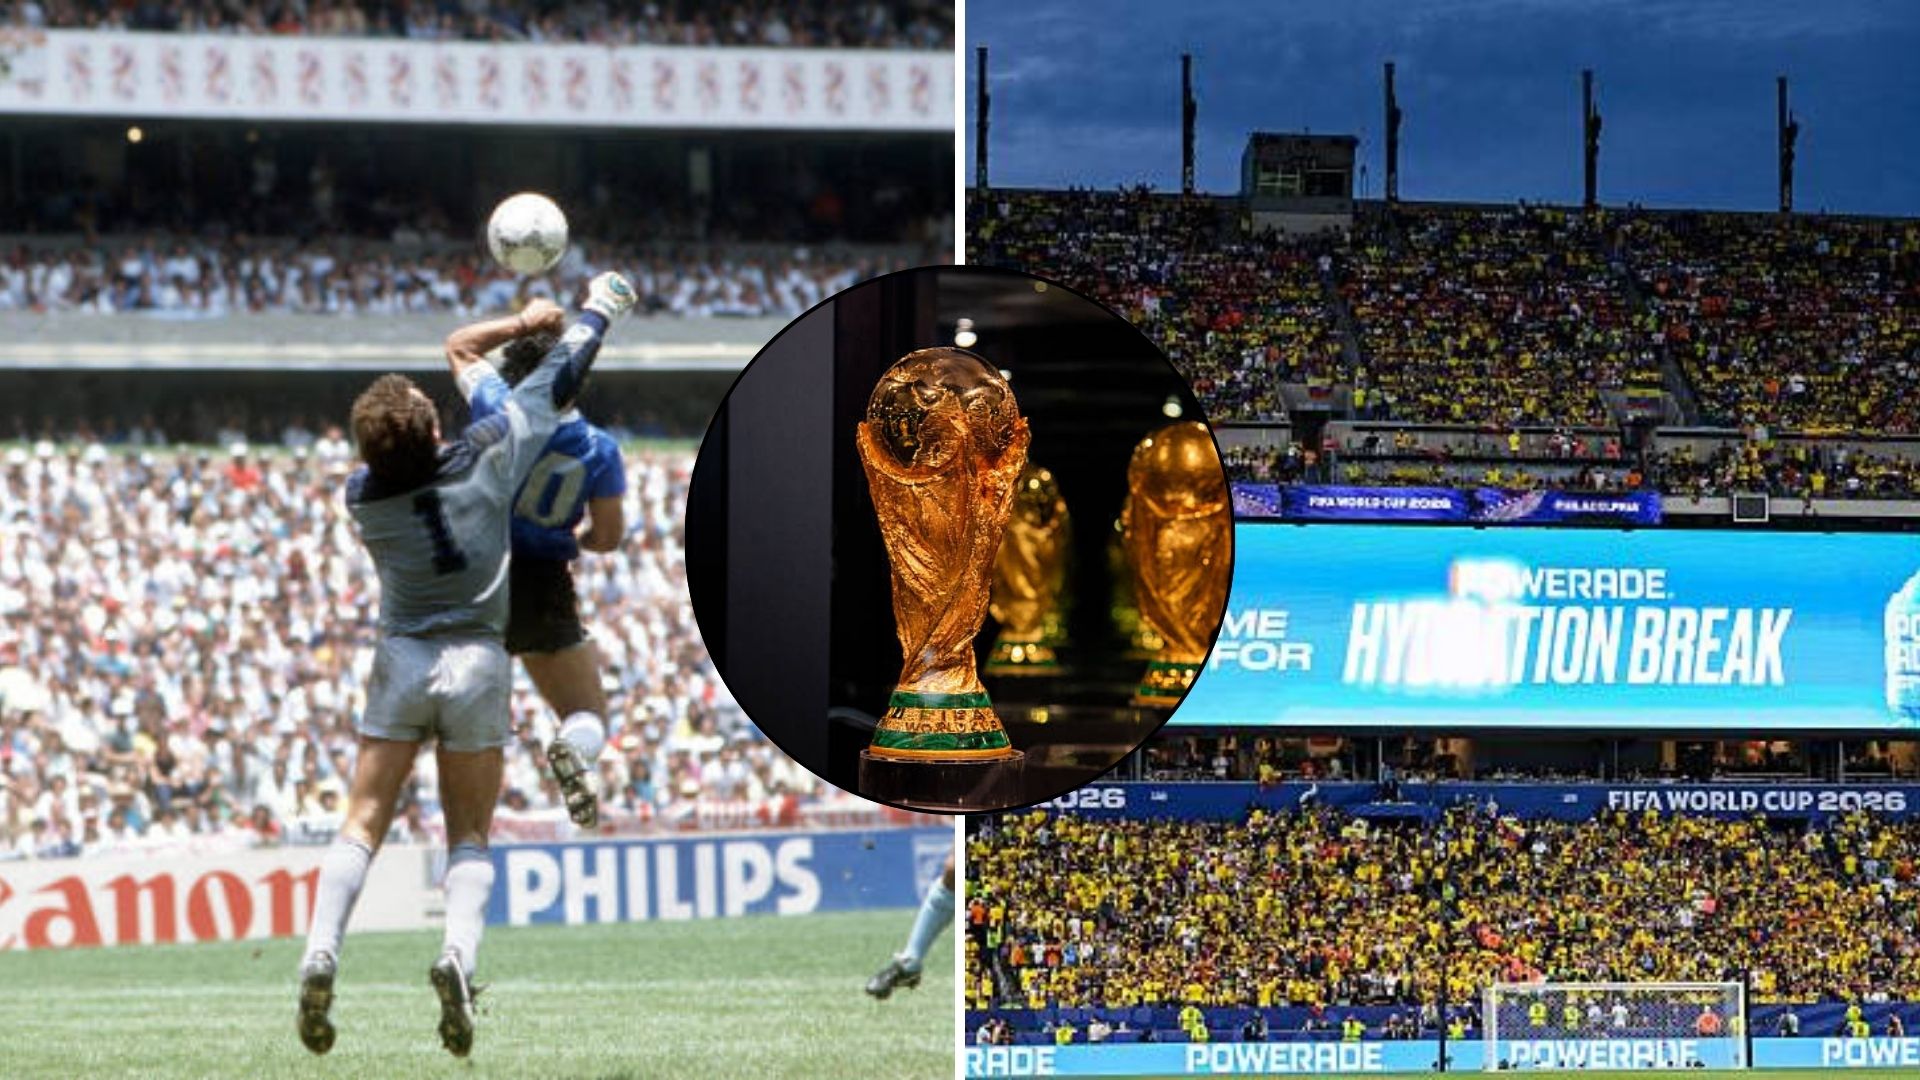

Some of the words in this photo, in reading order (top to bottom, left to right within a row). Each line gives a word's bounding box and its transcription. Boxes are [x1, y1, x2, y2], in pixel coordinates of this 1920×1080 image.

[412, 487, 470, 576] 1
[1457, 565, 1675, 600] WERADE.
[1218, 610, 1291, 639] ME
[1209, 641, 1315, 672] FOR
[1343, 602, 1624, 685] HYTION
[1627, 607, 1793, 686] BREAK
[904, 721, 966, 733] WORLD
[1608, 790, 1662, 811] FIFA
[1666, 790, 1759, 811] WORLD
[1762, 790, 1814, 811] CUP
[1817, 791, 1906, 811] 2026
[508, 838, 821, 926] PHILIPS
[0, 865, 322, 951] anon
[965, 1047, 1055, 1076] RADE
[1185, 1042, 1383, 1073] POWERADE
[1510, 1039, 1698, 1069] POWERADE
[1822, 1037, 1920, 1068] POWE
